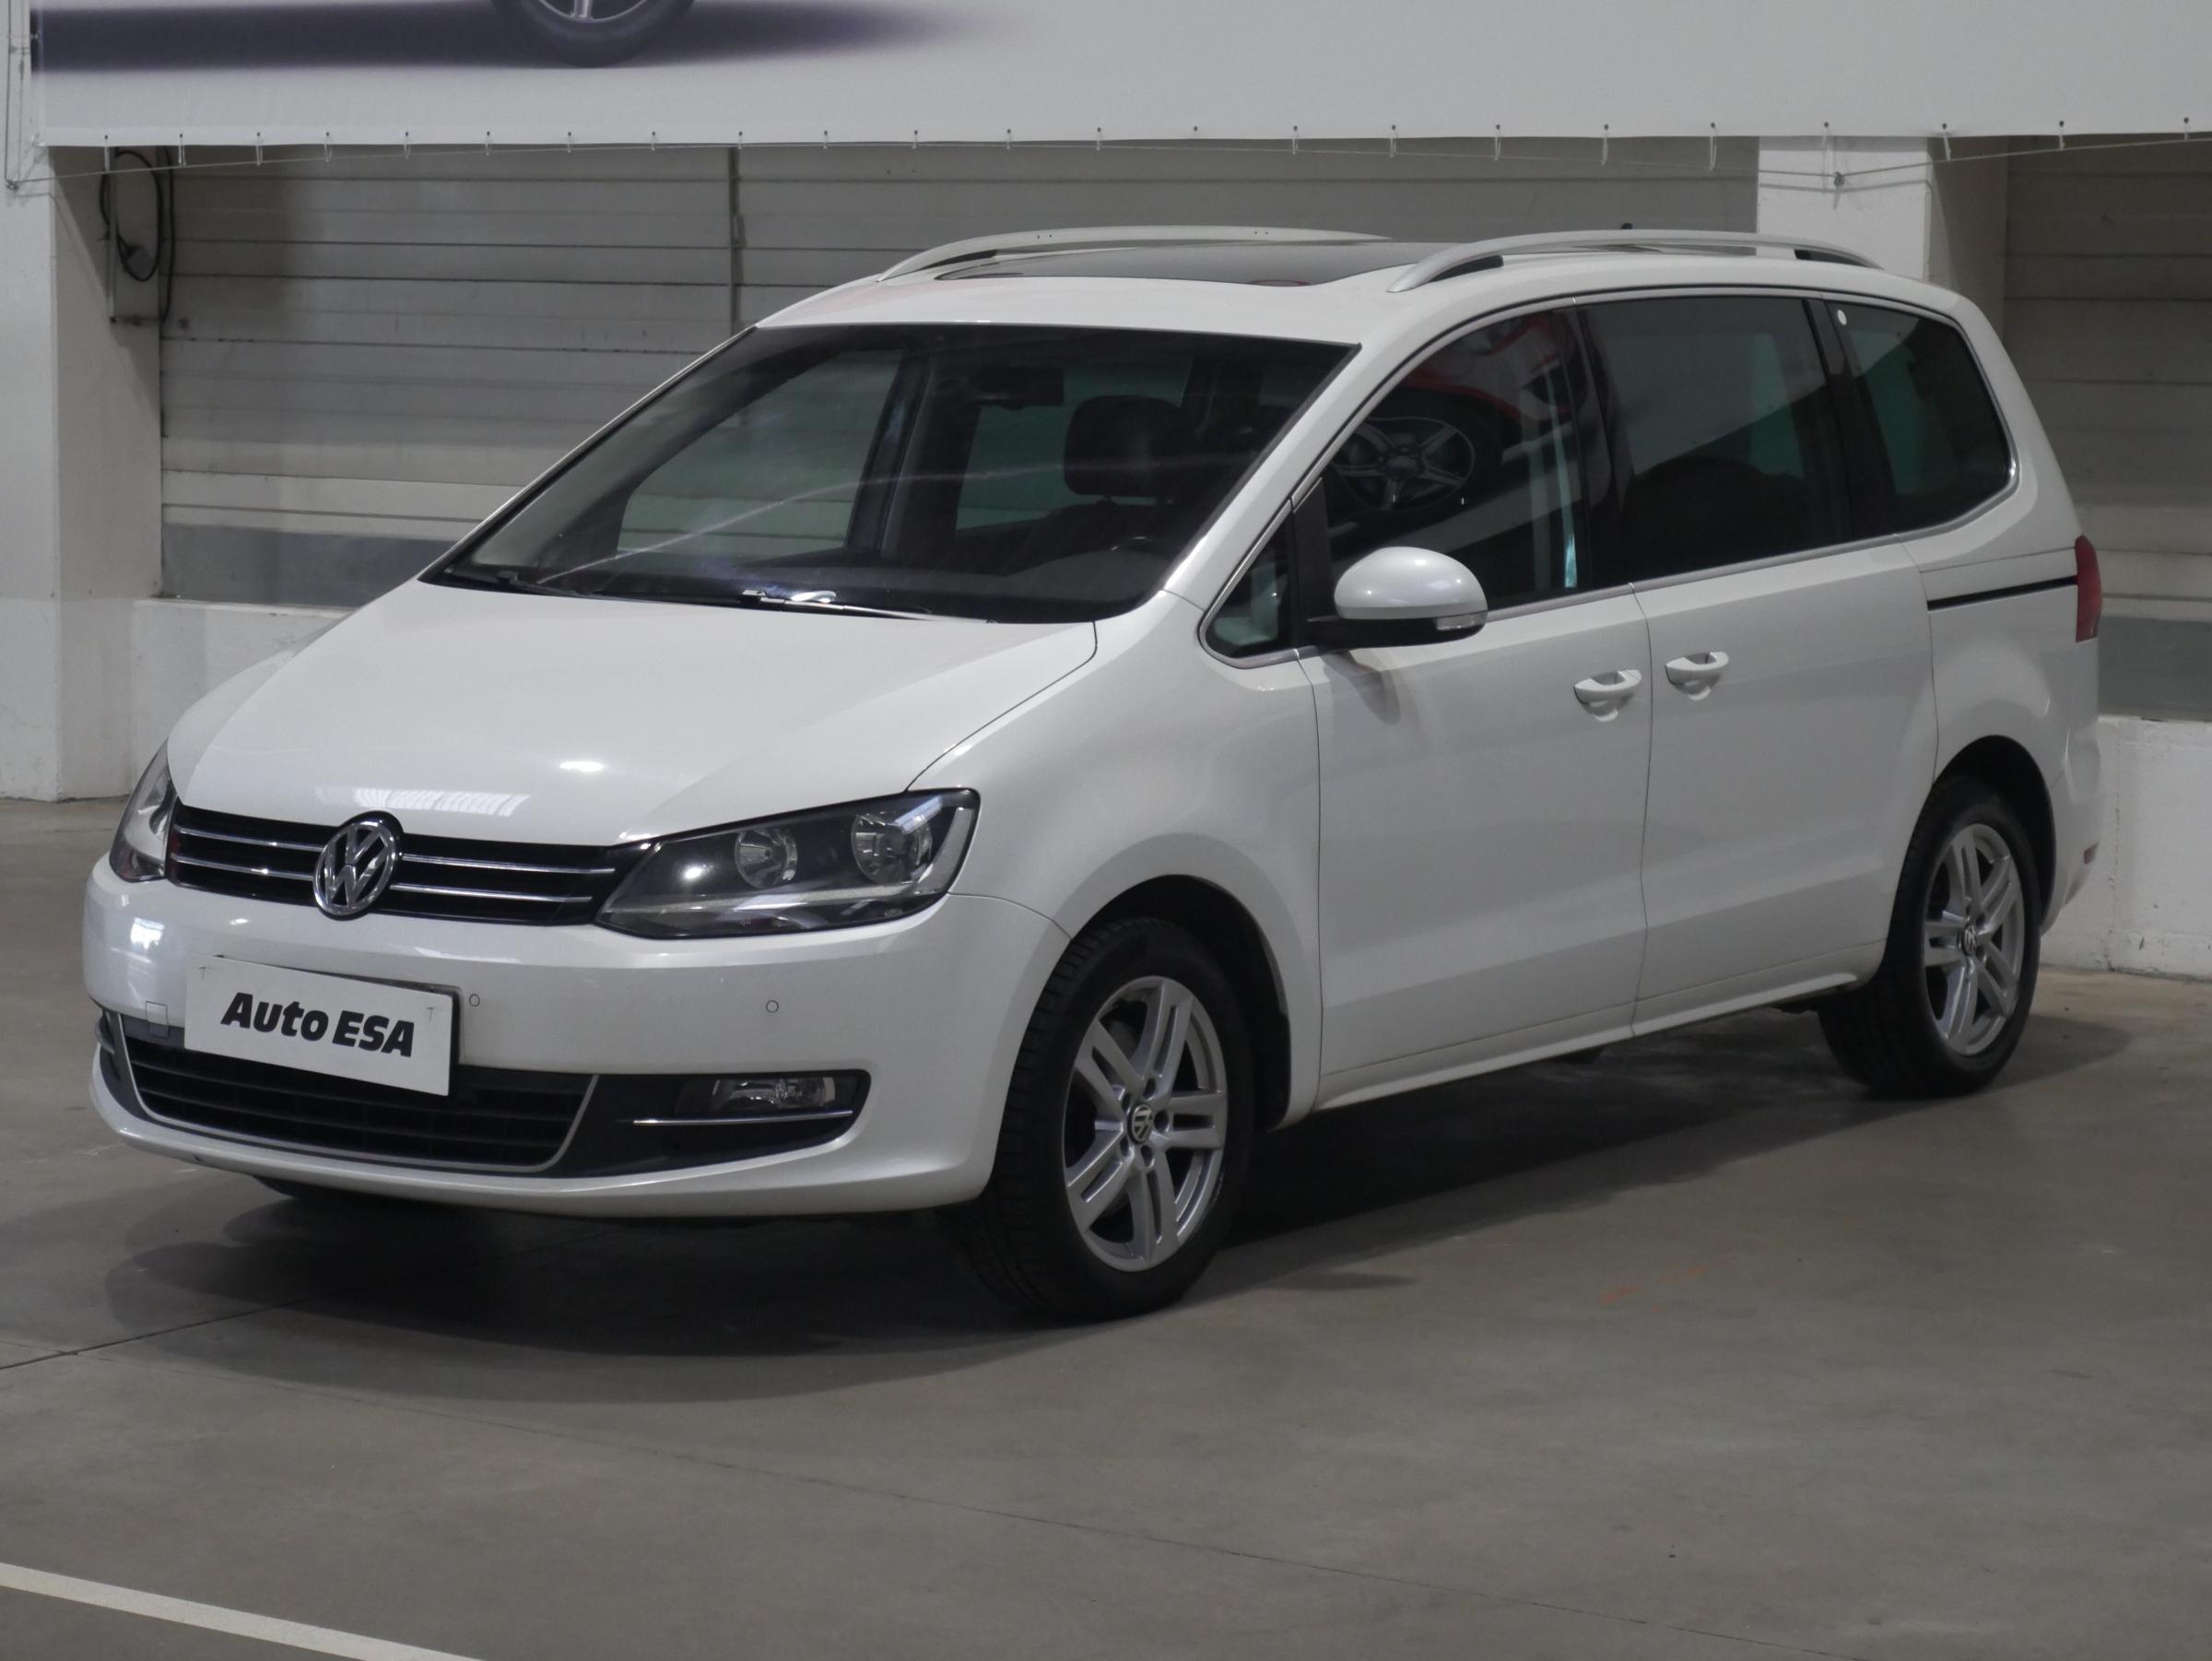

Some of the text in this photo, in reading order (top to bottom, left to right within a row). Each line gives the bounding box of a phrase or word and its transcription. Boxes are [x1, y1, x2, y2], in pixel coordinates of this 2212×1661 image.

[317, 821, 395, 914] VW
[220, 992, 415, 1057] Auto ESA
